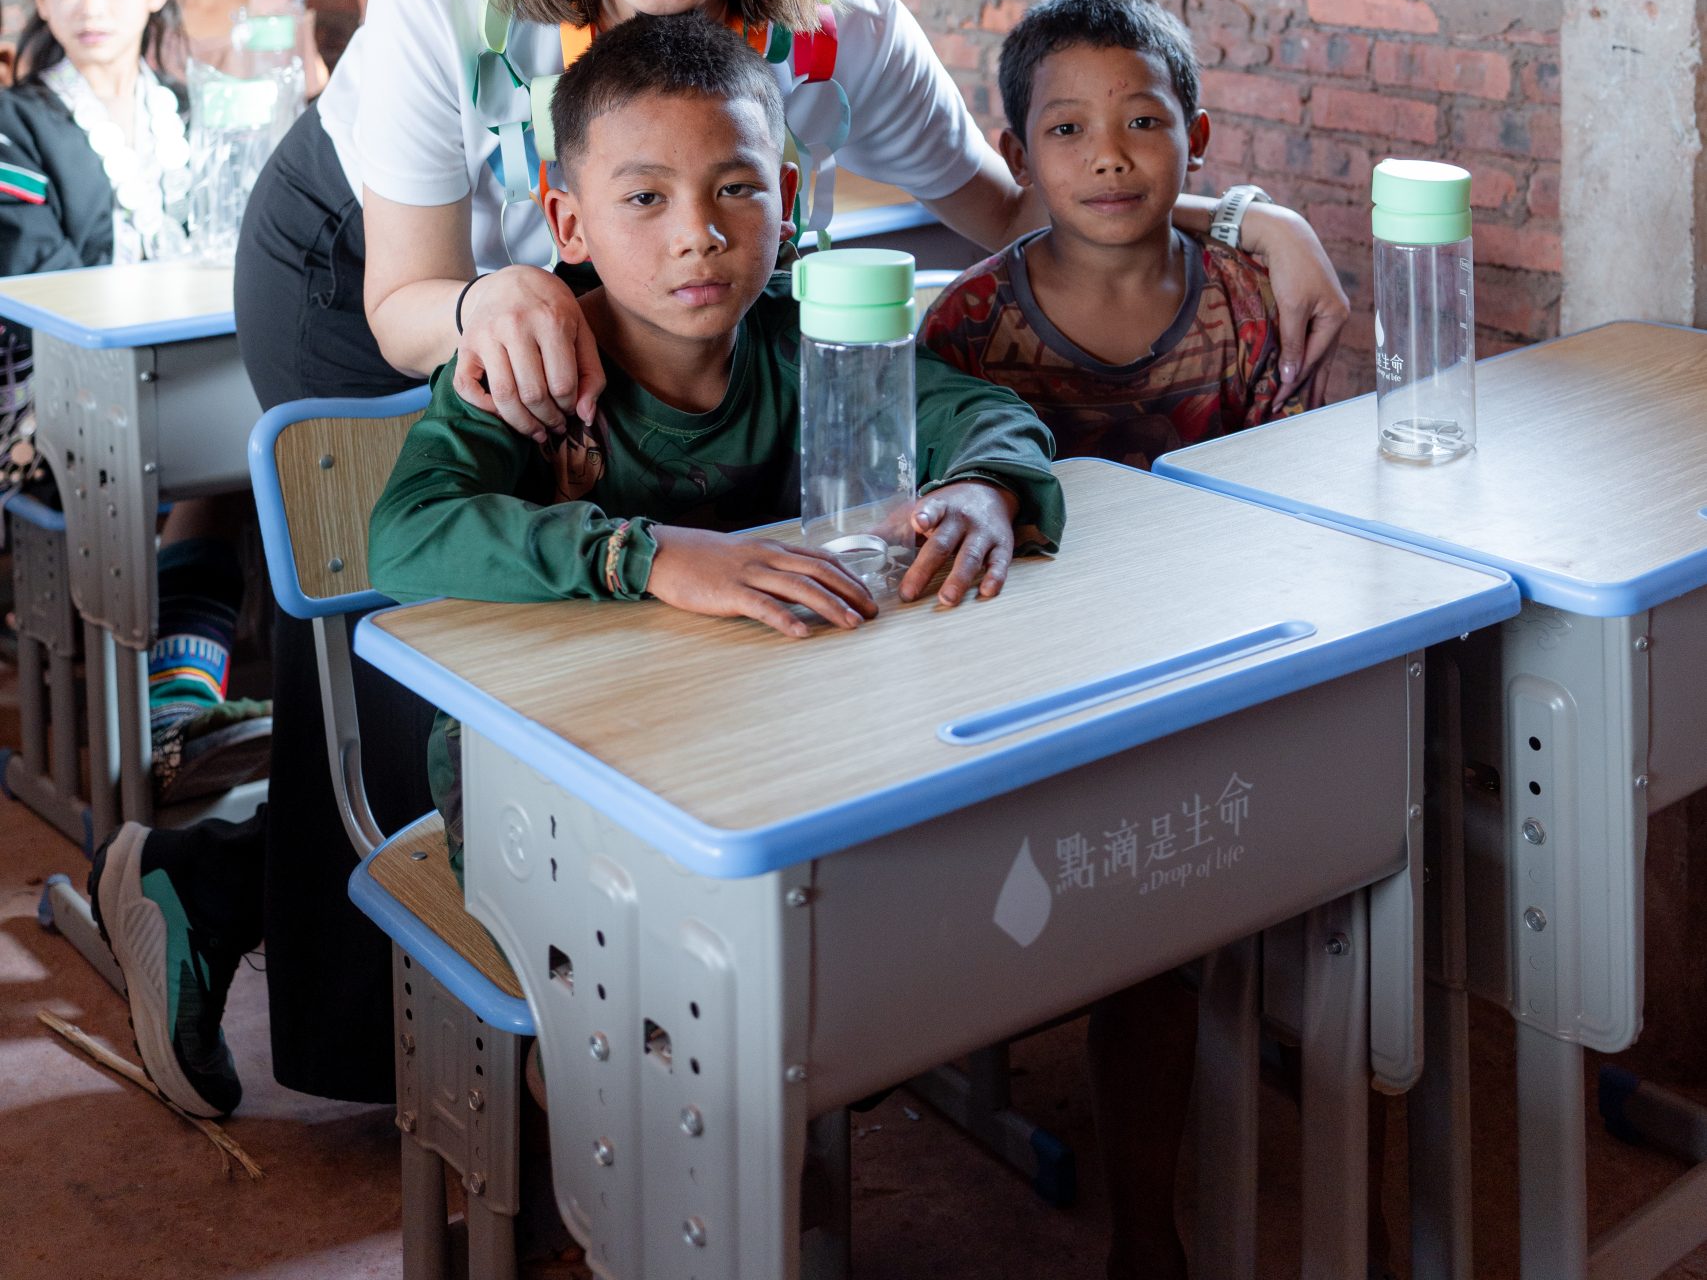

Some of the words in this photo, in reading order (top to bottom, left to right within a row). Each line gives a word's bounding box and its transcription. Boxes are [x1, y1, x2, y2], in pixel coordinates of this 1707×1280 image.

[1056, 771, 1254, 895] 點滴是生命
[1139, 882, 1149, 895] a
[1151, 862, 1193, 891] Drop
[1195, 853, 1212, 878] of
